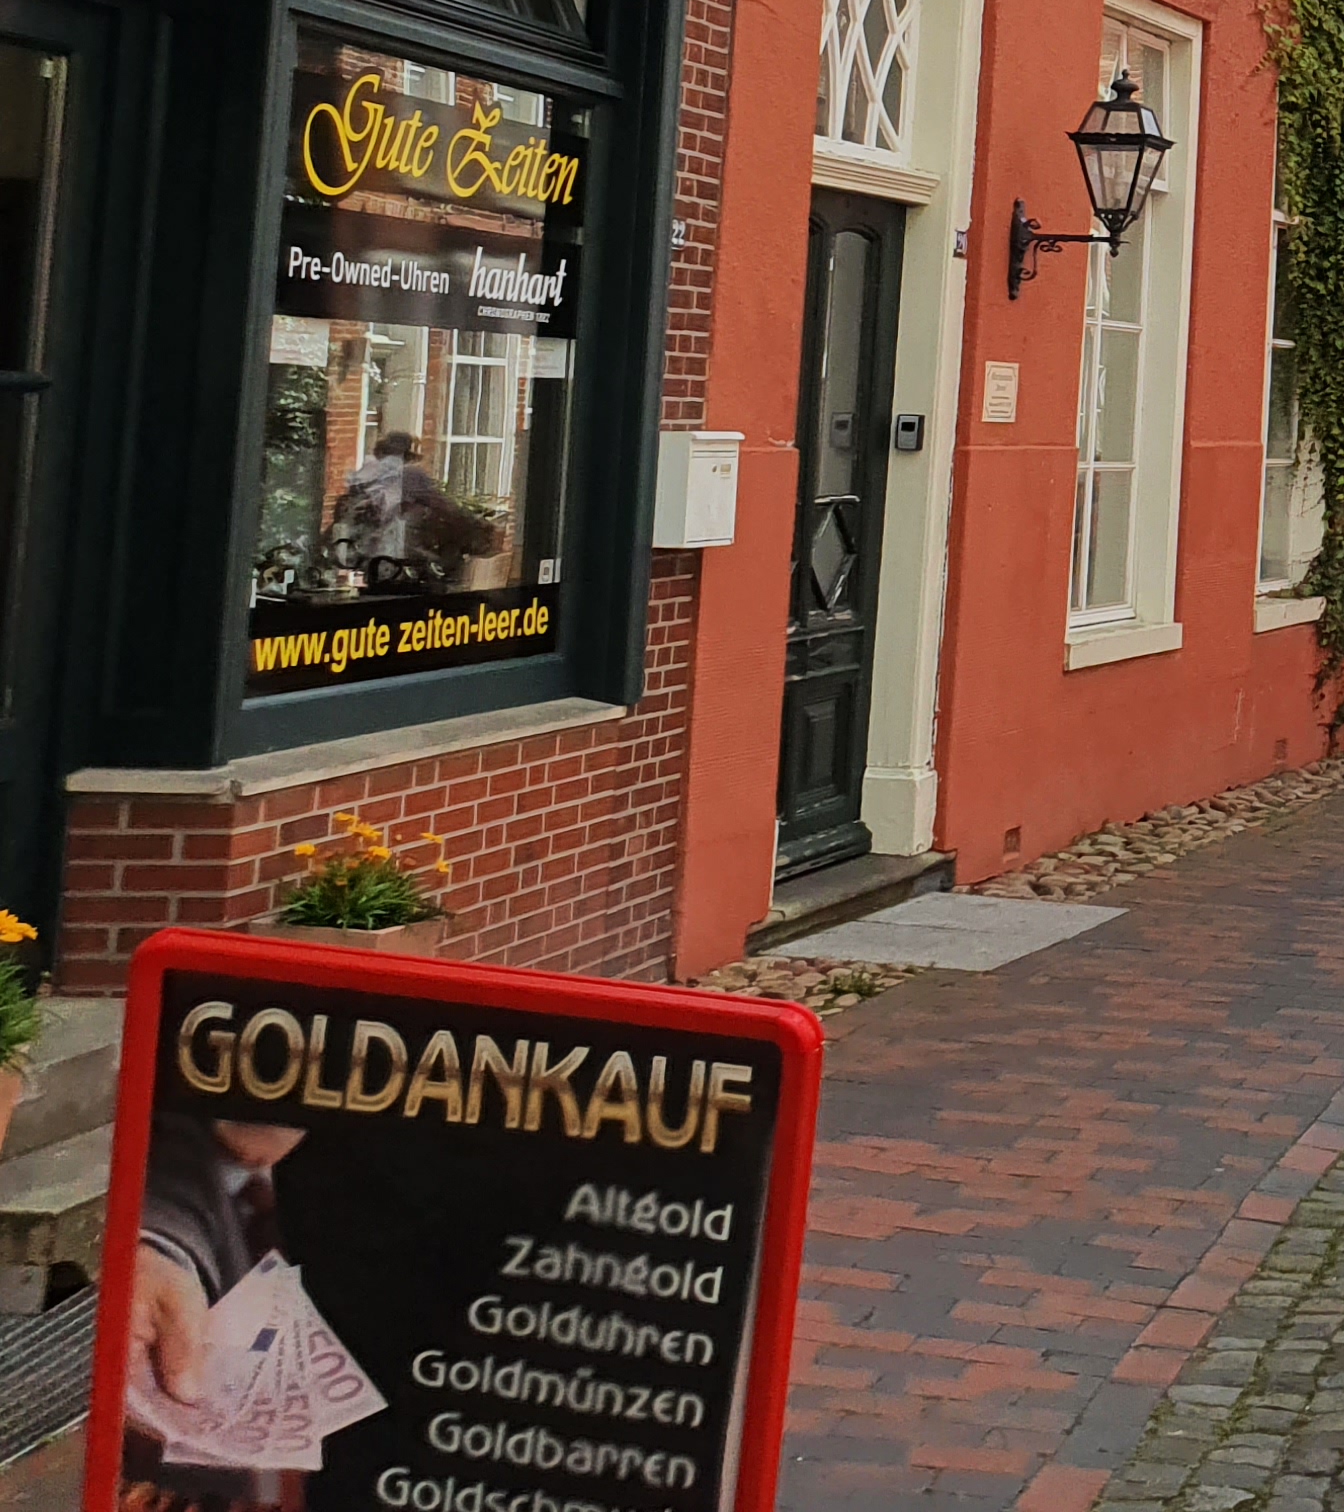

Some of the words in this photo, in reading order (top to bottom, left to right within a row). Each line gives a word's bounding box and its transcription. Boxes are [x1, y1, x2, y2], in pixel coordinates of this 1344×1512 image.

[303, 73, 435, 196] Gute
[446, 100, 580, 206] Zeiten
[671, 219, 686, 245] 22
[288, 246, 450, 295] Pre-Owned-Uhren
[468, 246, 567, 307] hanhart
[254, 617, 390, 673] www.gute
[397, 597, 549, 653] zeiten-leer.de
[176, 1000, 754, 1154] GOLDANKAUF
[563, 1181, 734, 1242] Altgold
[500, 1235, 725, 1304] Zahngold
[467, 1294, 715, 1366] Golduhren
[411, 1349, 705, 1428] Goldmünzen
[427, 1410, 697, 1489] Goldbarren
